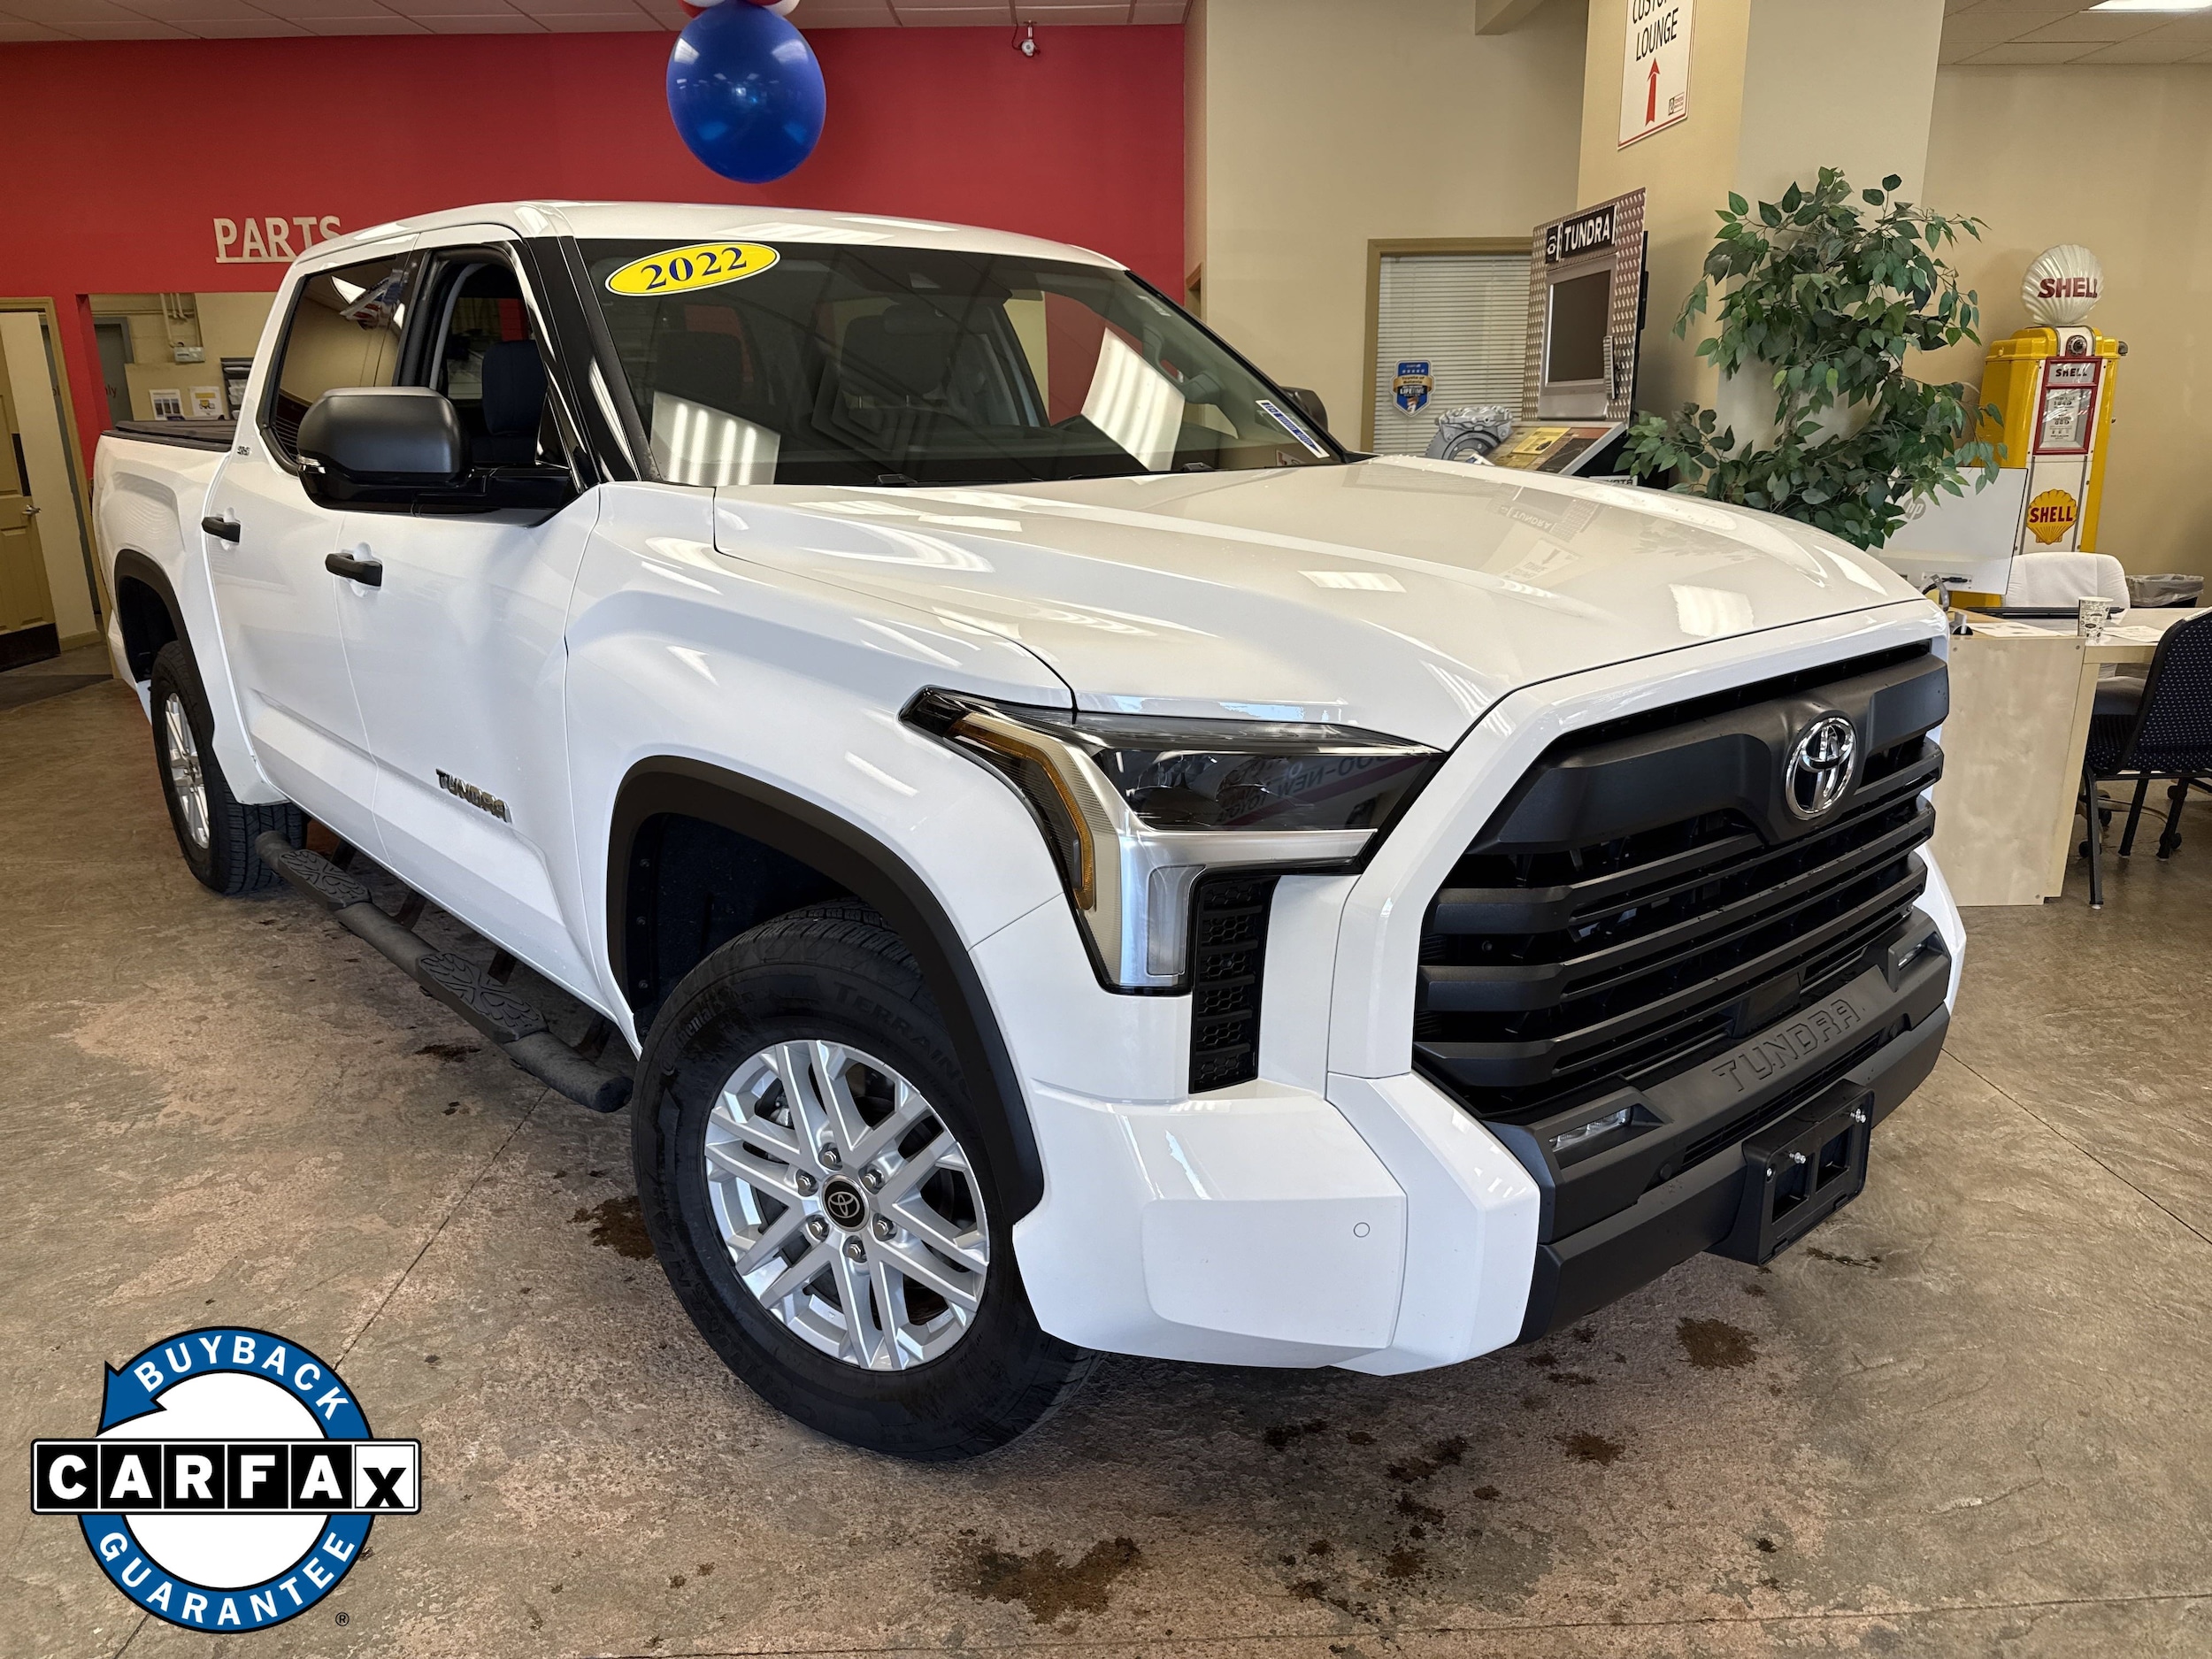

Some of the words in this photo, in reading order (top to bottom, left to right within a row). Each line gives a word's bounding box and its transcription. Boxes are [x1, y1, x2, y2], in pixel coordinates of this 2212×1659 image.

[1636, 7, 1678, 61] LOUNGE
[213, 215, 342, 258] PARTS
[1564, 213, 1610, 252] TUNDRA
[641, 247, 747, 291] 2022
[2038, 277, 2098, 299] SHELL
[2055, 367, 2088, 378] SHELL
[1907, 498, 1924, 519] hp
[2029, 505, 2074, 523] SHELL
[434, 767, 512, 824] TUNDRA
[1711, 999, 1861, 1092] TUNDRA
